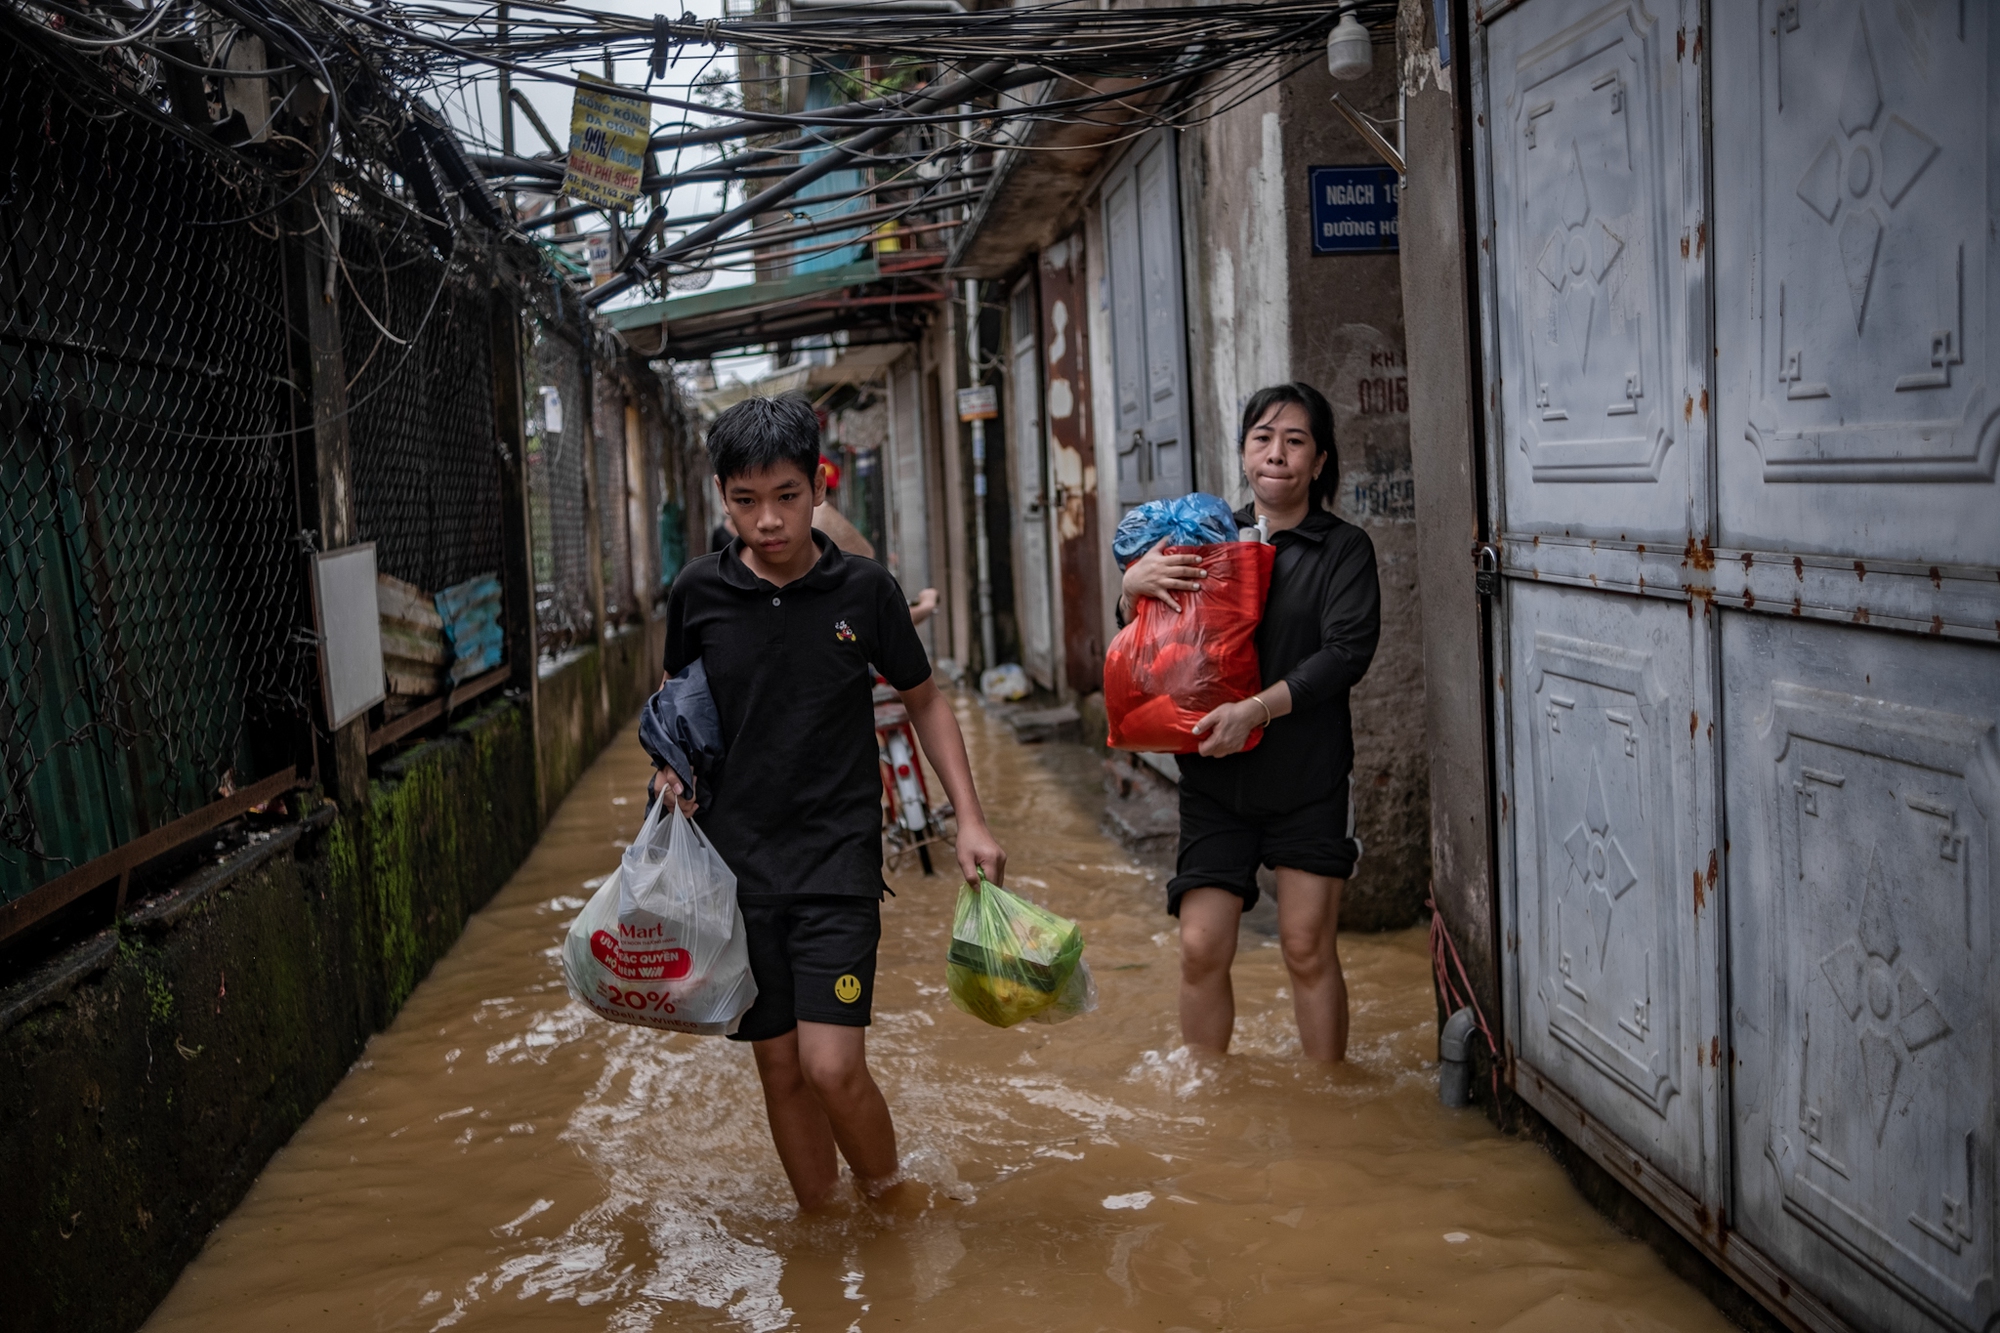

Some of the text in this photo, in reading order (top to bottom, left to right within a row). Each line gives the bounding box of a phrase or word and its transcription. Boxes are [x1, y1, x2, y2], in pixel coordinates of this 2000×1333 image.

[585, 113, 602, 126] DA
[594, 165, 614, 182] PHÍ
[614, 171, 639, 189] SHIP
[1322, 216, 1376, 238] ĐƯỜNG
[619, 922, 664, 938] Mart
[640, 950, 679, 965] QUYỀN
